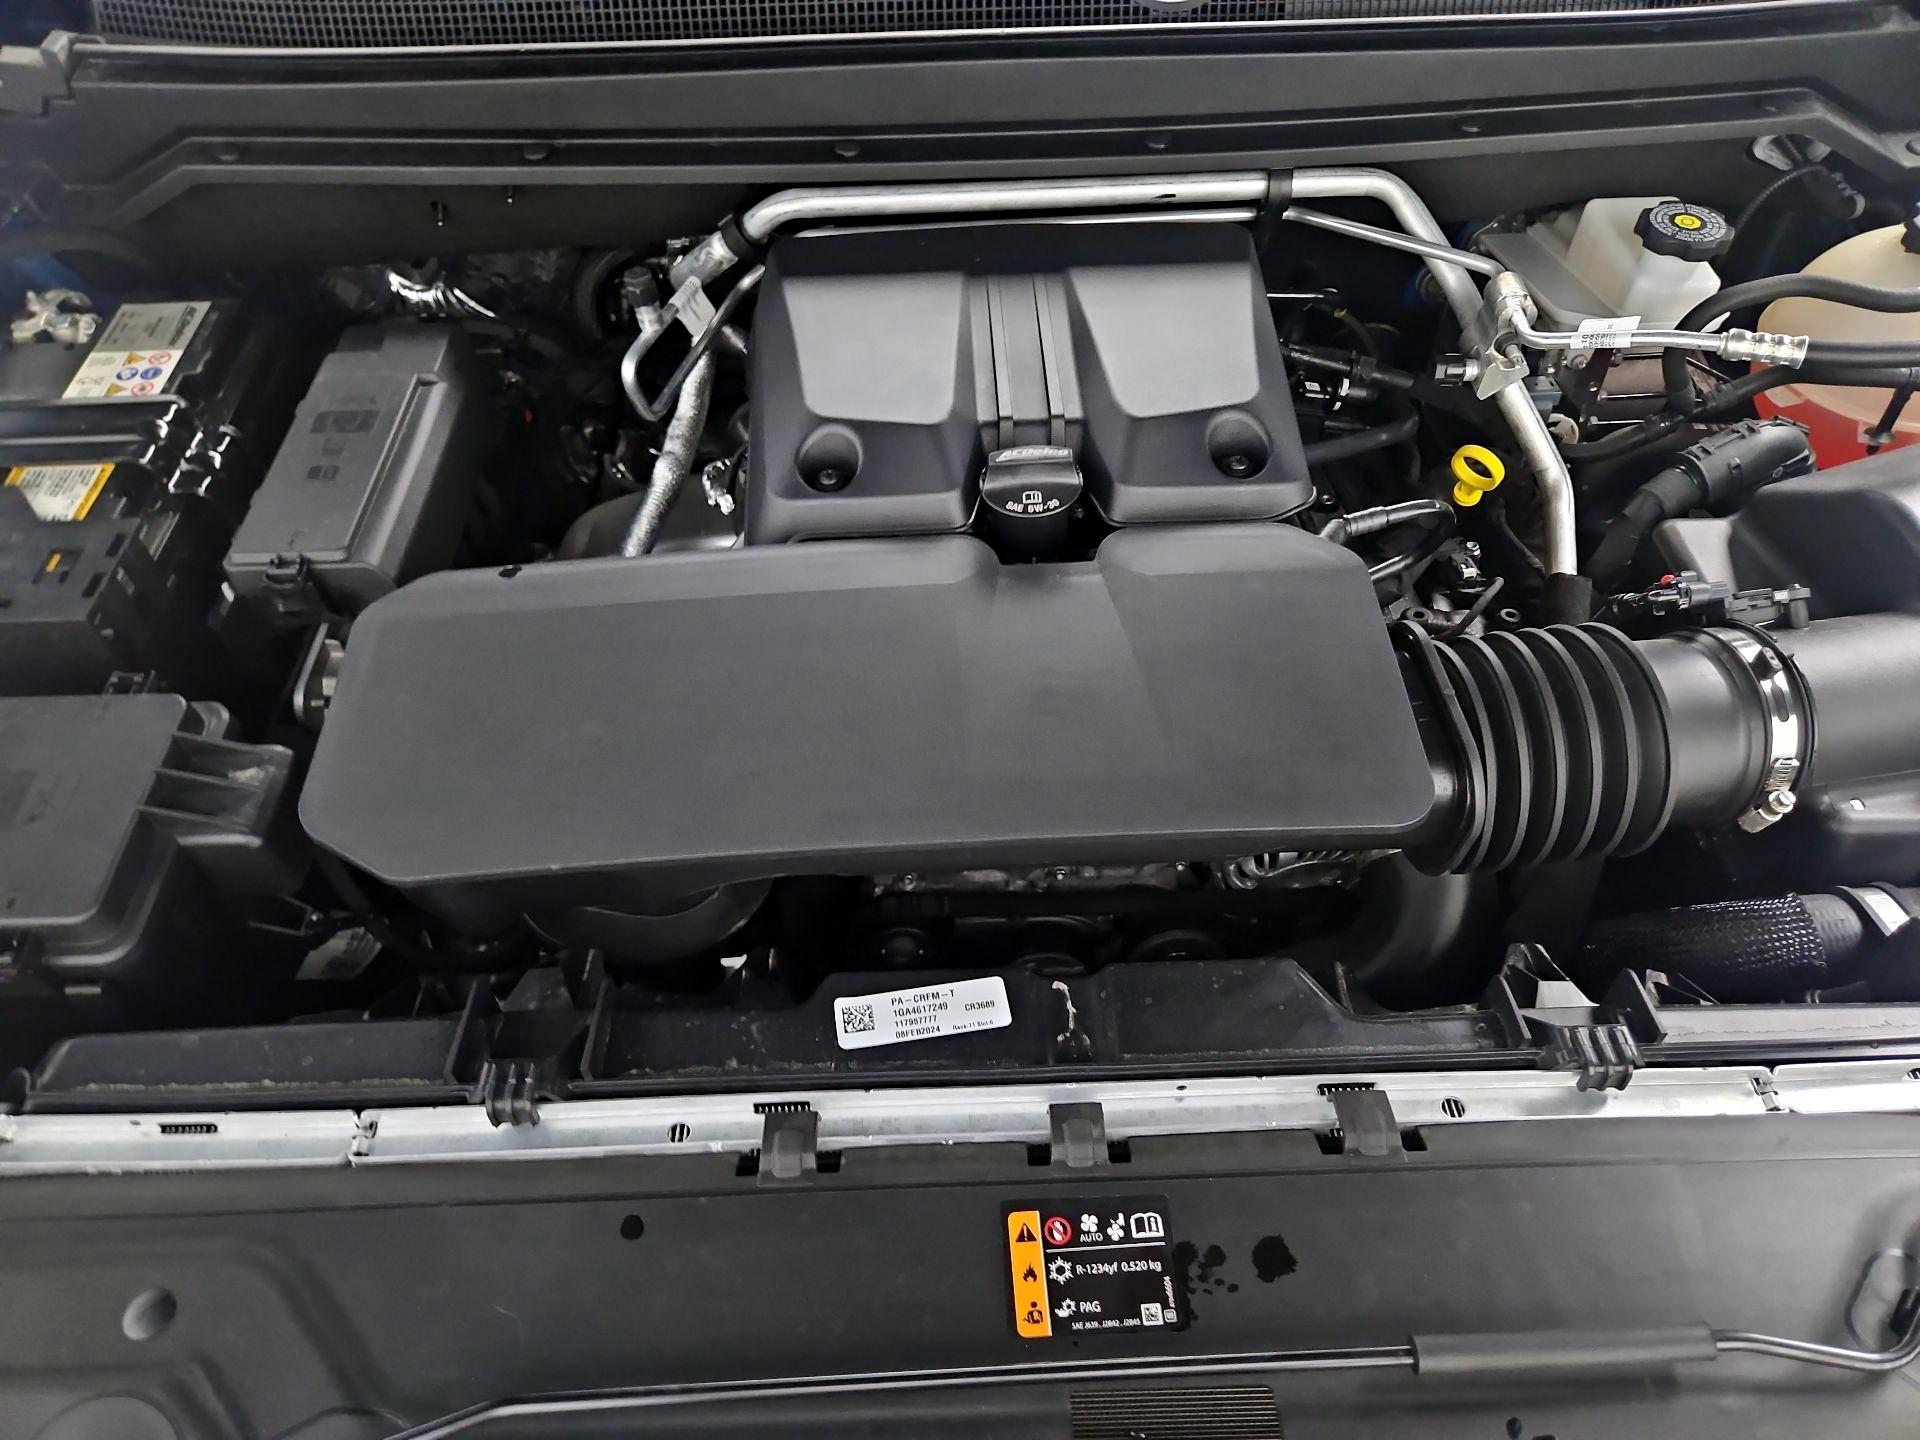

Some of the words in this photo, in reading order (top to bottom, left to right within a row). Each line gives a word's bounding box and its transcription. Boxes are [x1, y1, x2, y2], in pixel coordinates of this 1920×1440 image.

[1005, 500, 1024, 513] SAE
[964, 1000, 996, 1012] CR3689
[895, 1026, 941, 1039] 08FEB2024
[1079, 1232, 1104, 1243] AUTO
[1076, 1261, 1118, 1276] R-1234yf
[1120, 1260, 1148, 1273] 0.520
[1148, 1258, 1163, 1273] kg
[1079, 1300, 1102, 1314] PAG
[1071, 1320, 1084, 1330] SAE
